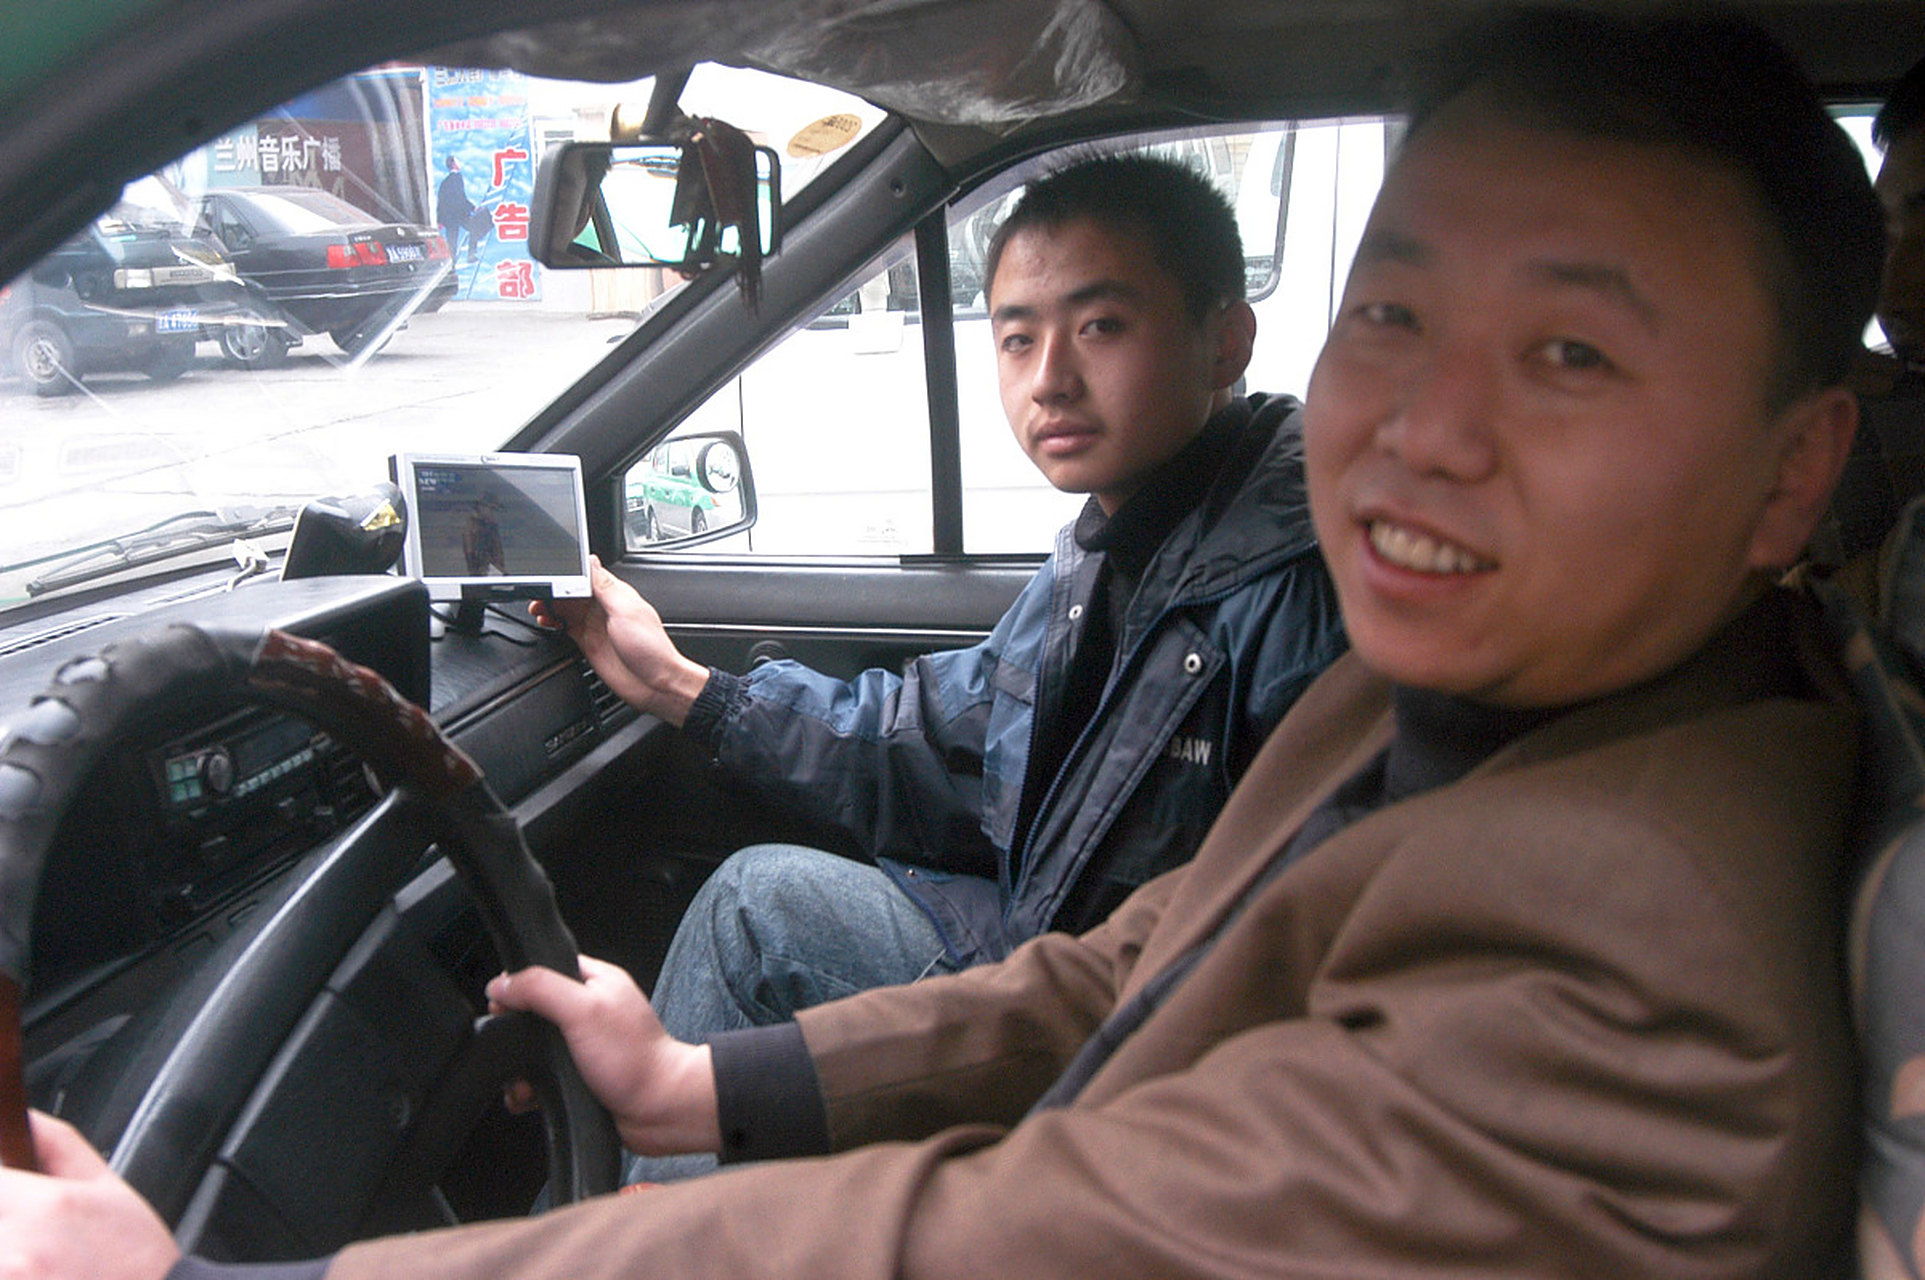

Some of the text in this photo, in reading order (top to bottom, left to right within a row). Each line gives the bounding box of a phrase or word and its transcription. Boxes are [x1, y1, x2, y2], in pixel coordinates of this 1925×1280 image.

[213, 134, 342, 173] 兰州音乐广播
[493, 148, 535, 299] 广告部
